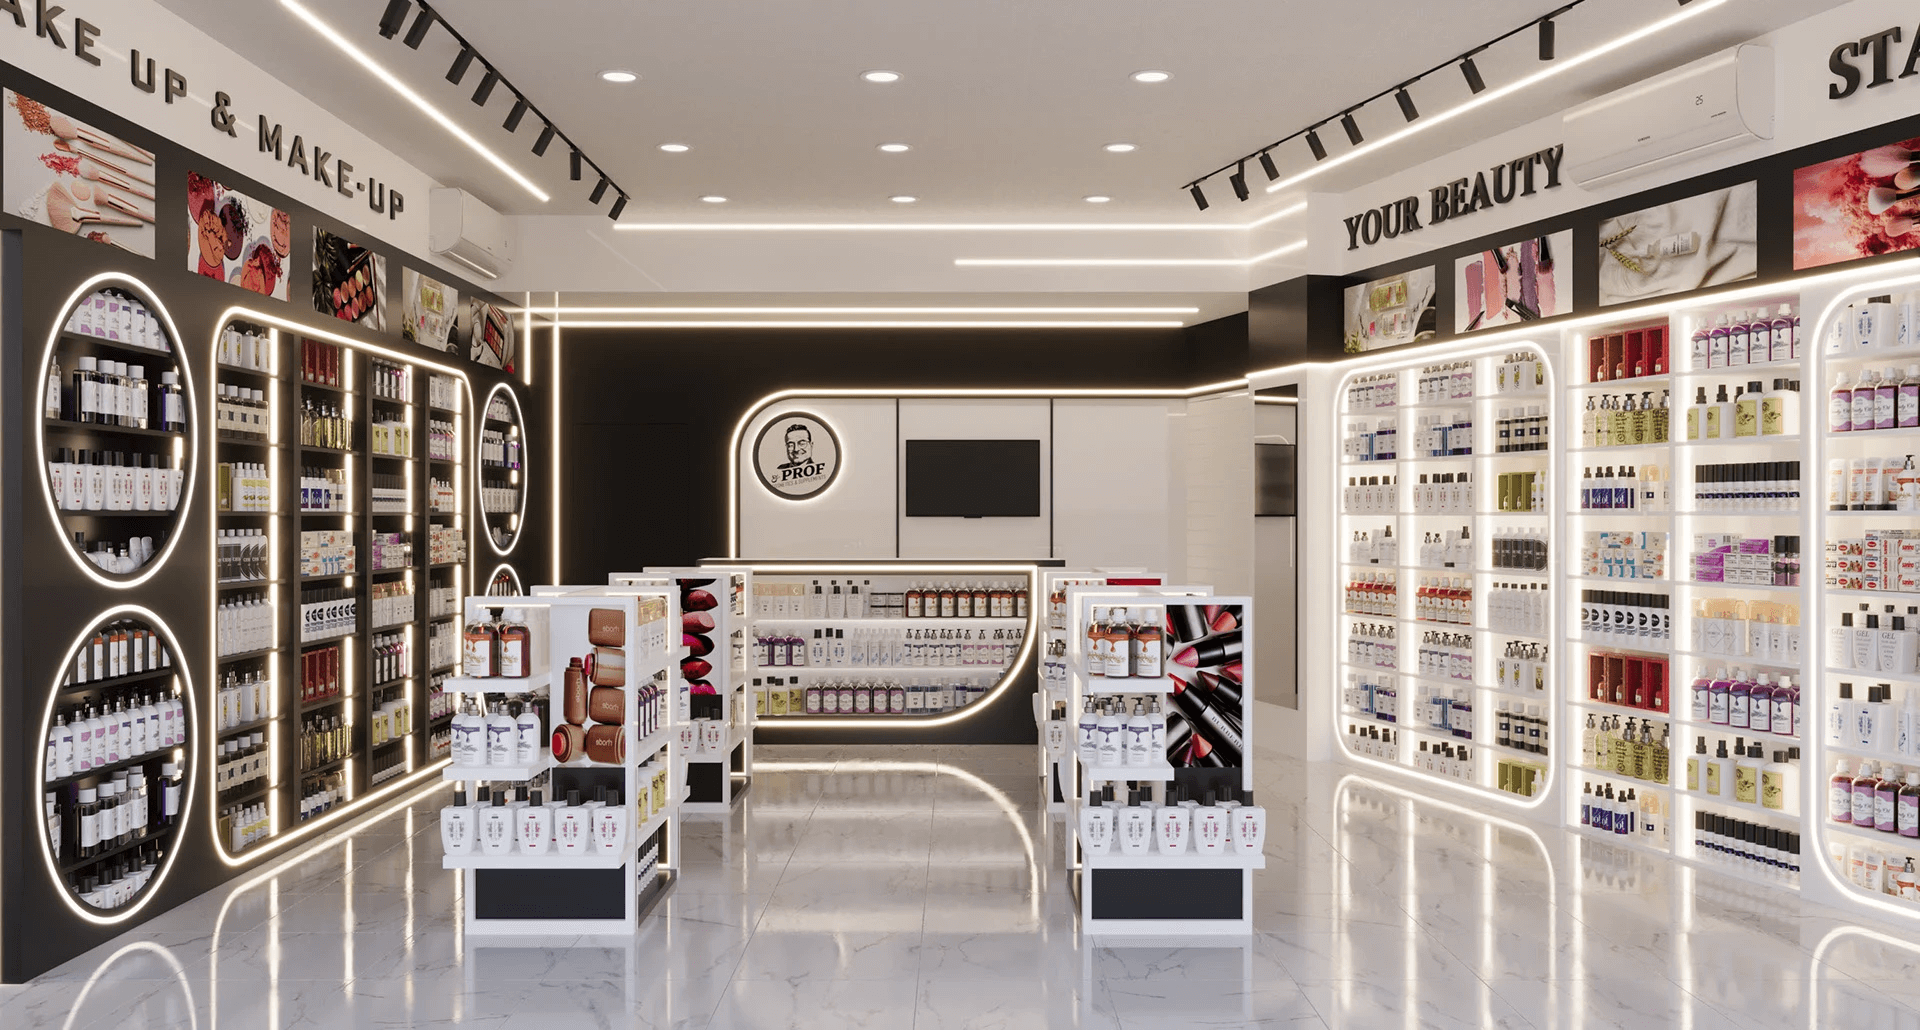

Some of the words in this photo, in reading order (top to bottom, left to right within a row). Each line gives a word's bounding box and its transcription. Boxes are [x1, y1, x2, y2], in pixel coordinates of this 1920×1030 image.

[1695, 94, 1704, 106] 25
[131, 49, 187, 104] UP
[211, 91, 237, 138] &
[258, 114, 404, 220] MAKE-UP
[1343, 195, 1423, 251] YOUR
[1428, 143, 1564, 225] BEAUTY
[781, 463, 826, 482] PROF
[1881, 632, 1896, 640] GEL
